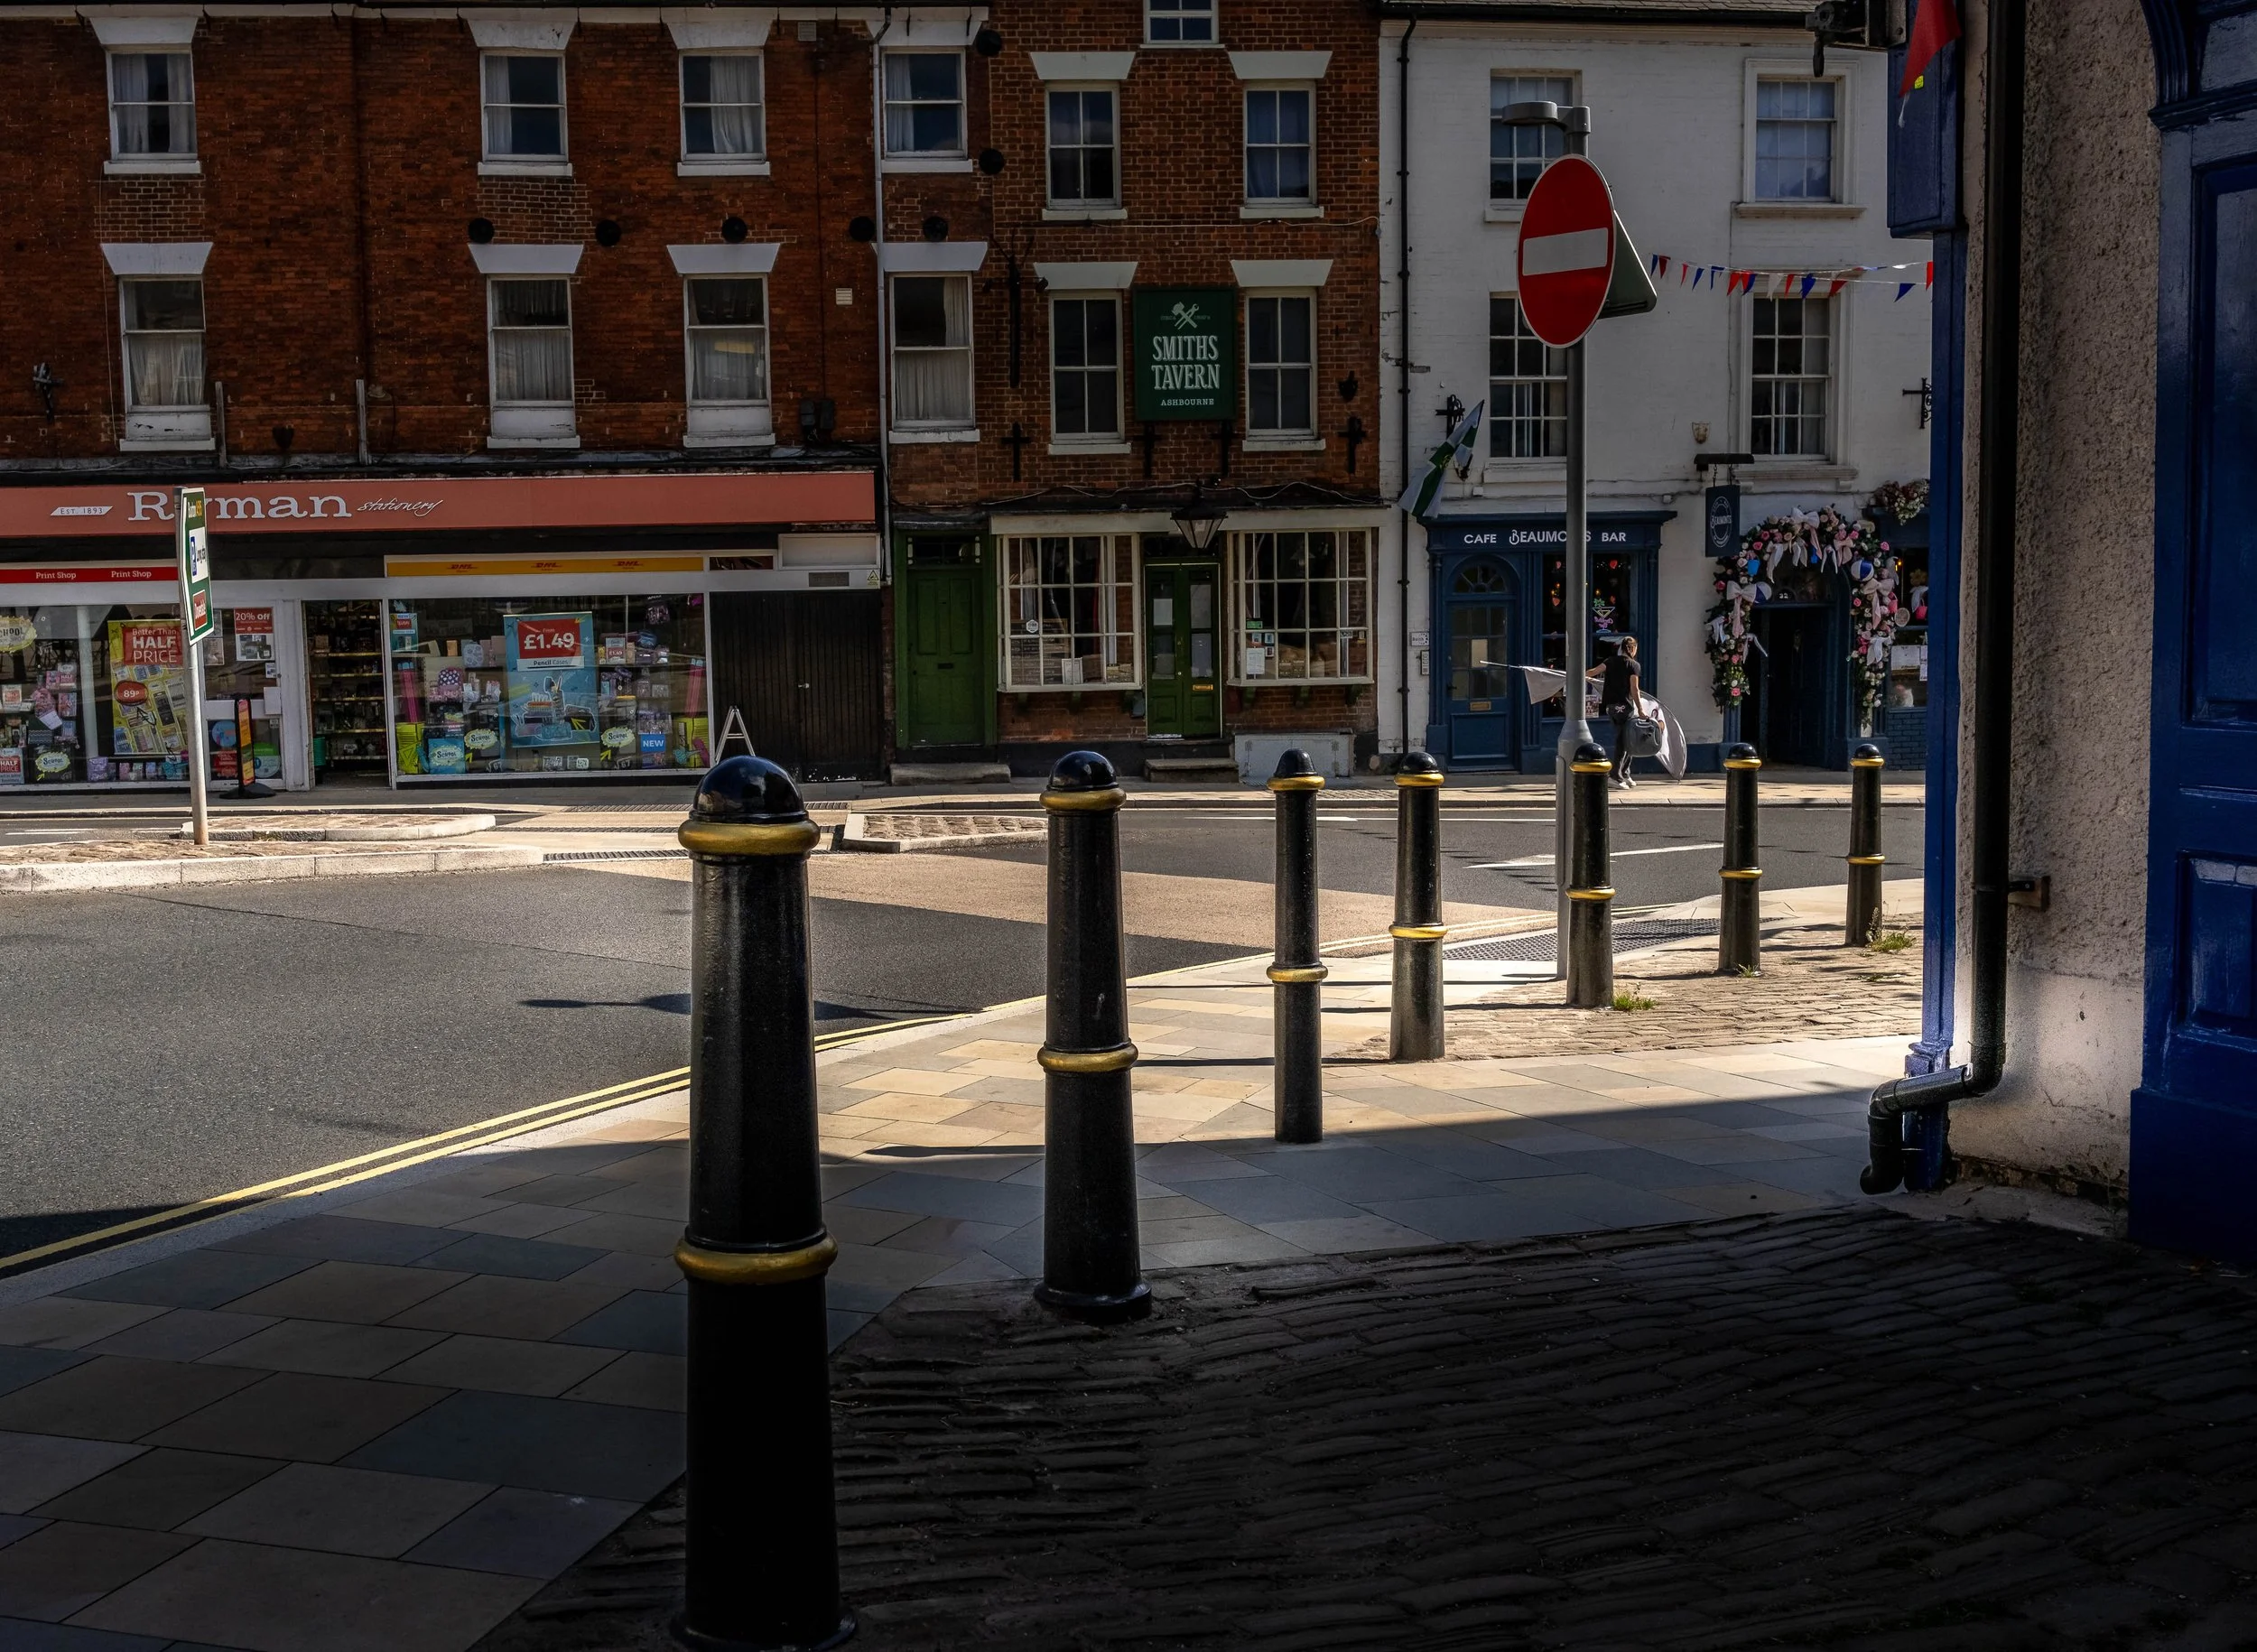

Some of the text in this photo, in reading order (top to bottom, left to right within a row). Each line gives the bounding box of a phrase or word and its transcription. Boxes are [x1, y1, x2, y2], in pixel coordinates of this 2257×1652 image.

[1152, 335, 1220, 362] SMITHS
[1151, 364, 1221, 390] TAVERN
[1160, 398, 1215, 406] ASHBOURNE
[127, 491, 444, 521] Rman stationery
[1463, 529, 1627, 545] CAFE BEAUMOS BAR
[57, 571, 77, 580] Shop
[132, 570, 152, 579] Shop
[236, 612, 255, 621] 20%
[133, 636, 177, 649] HALF
[524, 632, 575, 650] £1.49
[134, 650, 178, 663] PRICE
[643, 739, 664, 747] NEW
